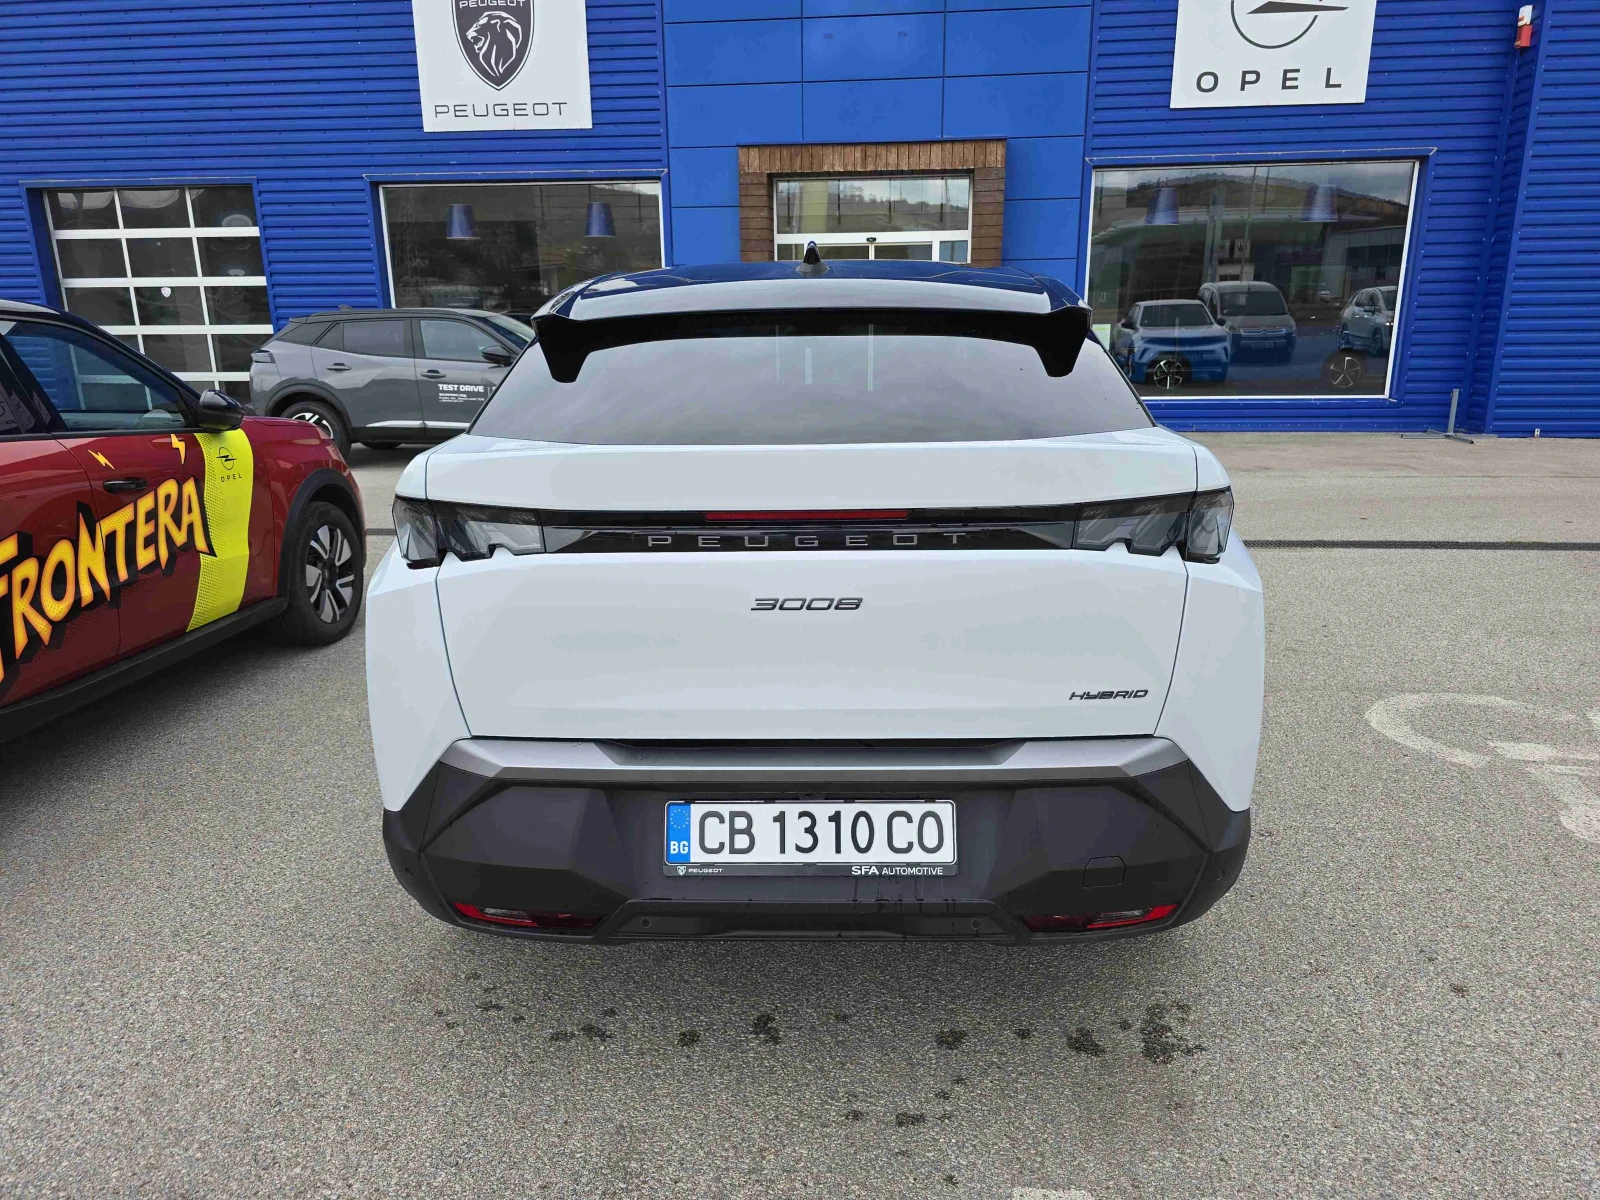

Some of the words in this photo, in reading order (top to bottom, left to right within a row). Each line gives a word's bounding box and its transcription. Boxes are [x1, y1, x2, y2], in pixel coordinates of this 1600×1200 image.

[459, 0, 525, 9] PEUGEOT
[1196, 67, 1342, 93] OPEL
[434, 102, 568, 119] PEUGEOT
[220, 473, 243, 483] OPEL
[647, 533, 967, 547] PEUGEOT
[750, 597, 864, 611] 3008
[1068, 689, 1149, 701] HYBRID
[698, 810, 756, 855] CB
[772, 810, 875, 855] 1310
[886, 810, 945, 855] CO
[670, 840, 689, 855] BG
[851, 865, 880, 875] SFA
[881, 867, 944, 875] AUTOMOTIVE
